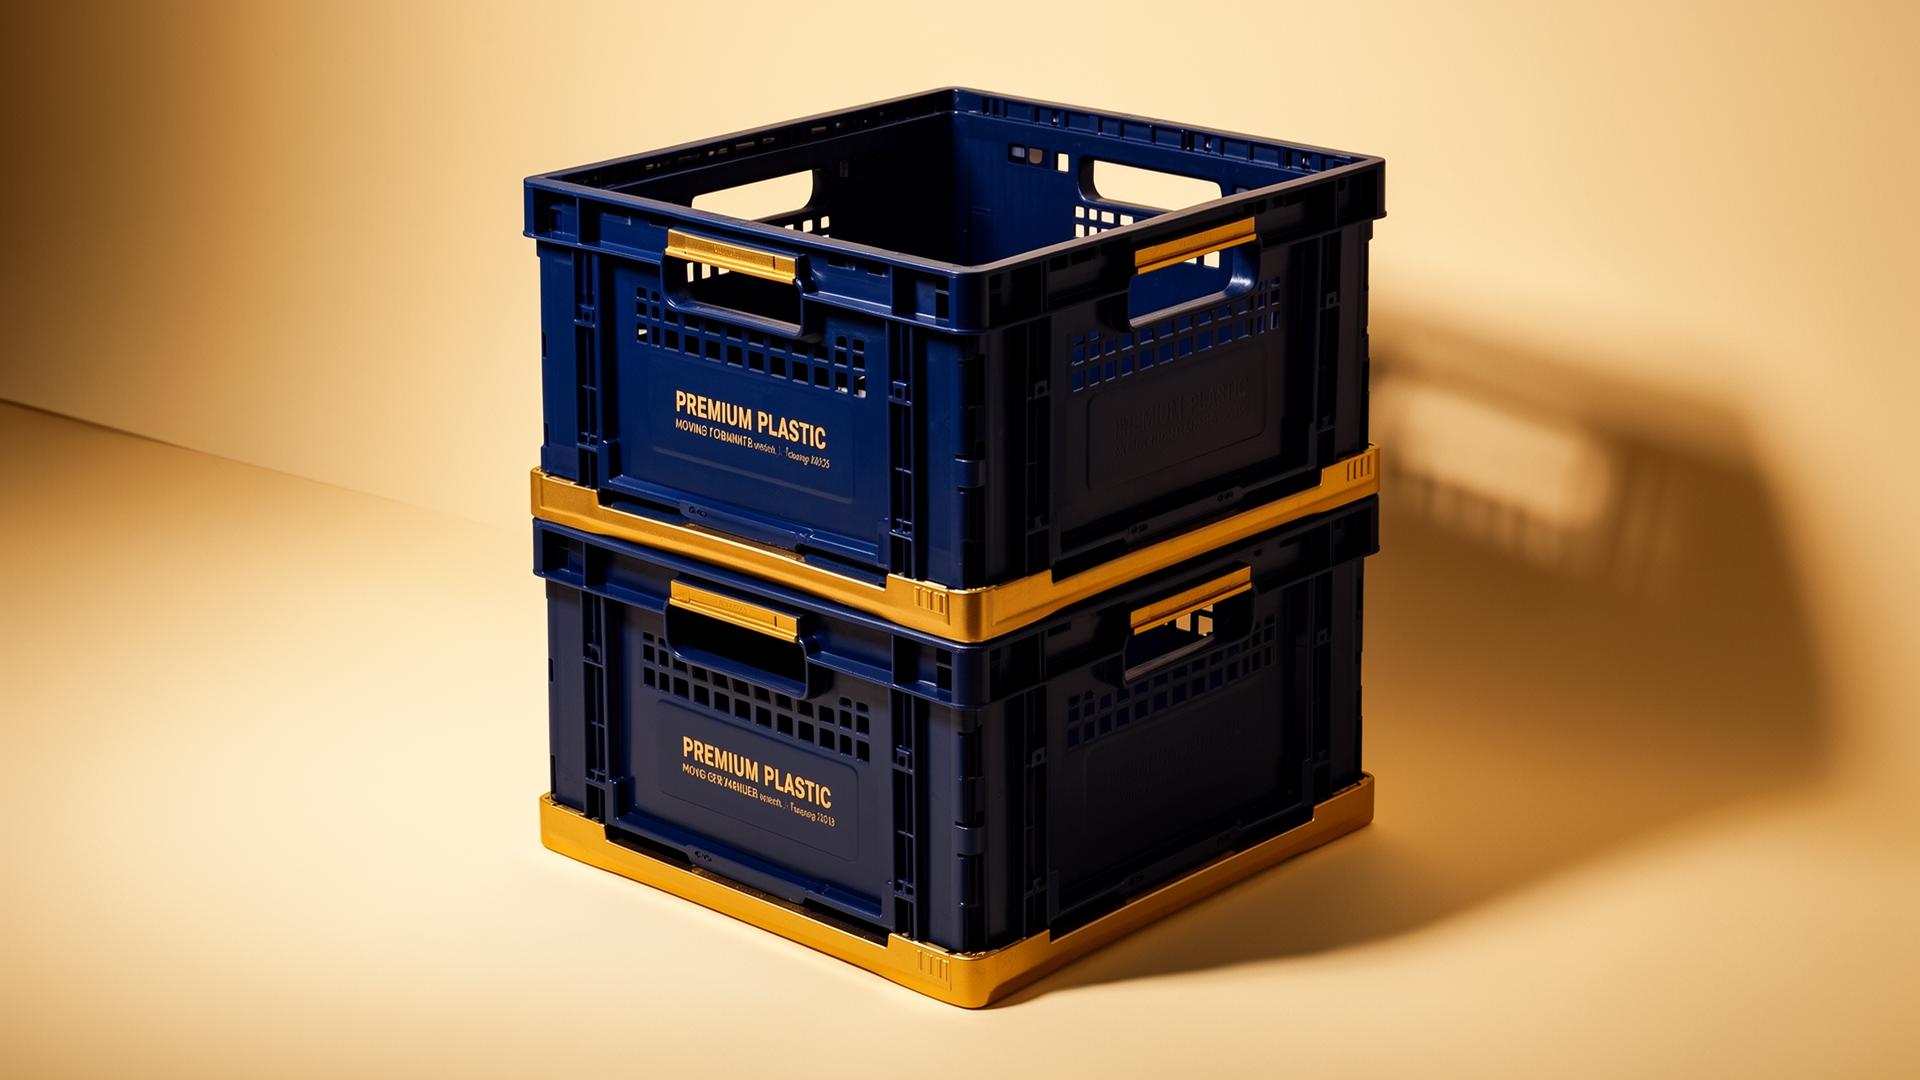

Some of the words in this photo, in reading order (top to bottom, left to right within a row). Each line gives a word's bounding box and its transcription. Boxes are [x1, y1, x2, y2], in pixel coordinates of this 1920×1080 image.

[675, 389, 752, 431] PREMIUM
[757, 410, 827, 450] PLASTIC
[682, 735, 759, 783] PREMIUM
[763, 764, 832, 809] PLASTIC
